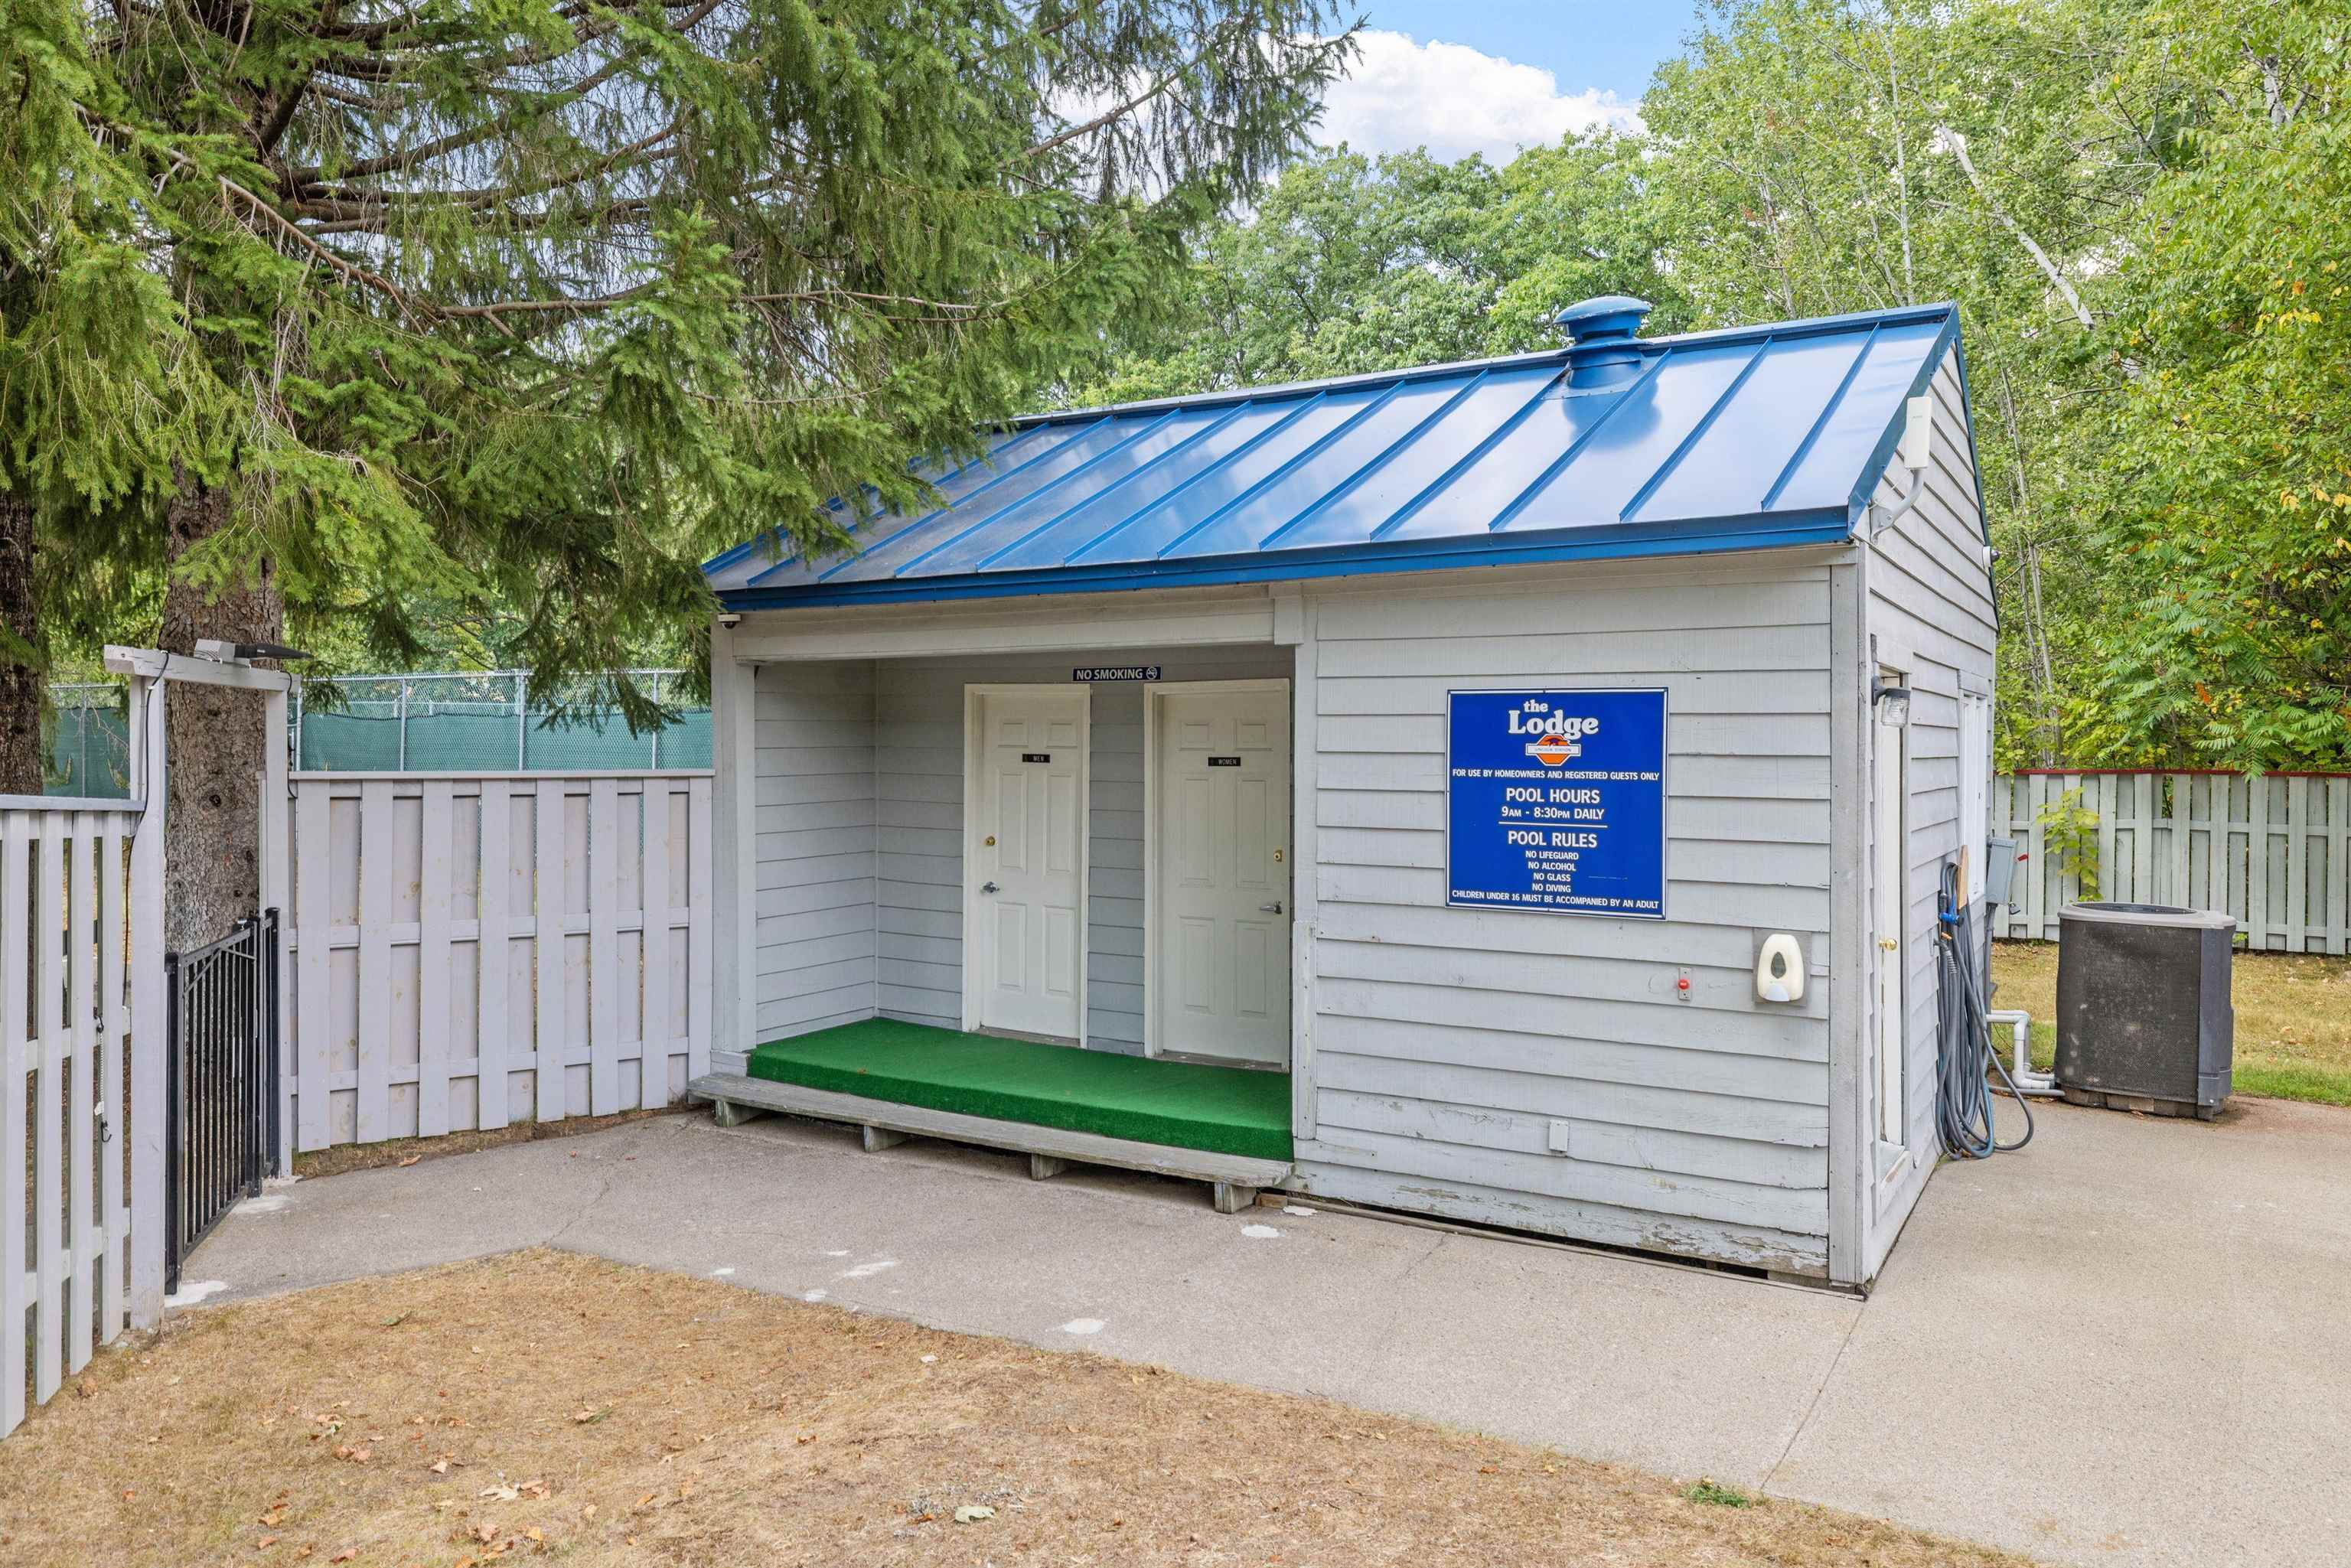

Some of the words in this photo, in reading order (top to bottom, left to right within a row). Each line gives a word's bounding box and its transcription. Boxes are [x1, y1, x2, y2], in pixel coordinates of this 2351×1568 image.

[1076, 670, 1092, 680] NO
[1094, 668, 1143, 680] SMOKING
[1523, 699, 1548, 713] the
[1508, 709, 1599, 740] Lodge
[1468, 769, 1481, 777] USE
[1495, 770, 1545, 778] HOMEOWNERS
[1547, 771, 1563, 779] AND
[1565, 771, 1608, 780] REGISTERED
[1610, 772, 1638, 781] GUESTS
[1641, 772, 1660, 781] ONLY
[1506, 788, 1544, 803] POOL
[1550, 789, 1600, 804] HOURS
[1502, 807, 1521, 817] 9AM
[1534, 807, 1570, 820] 8:30PM
[1574, 809, 1604, 820] DAILY
[1508, 831, 1546, 846] POOL
[1552, 833, 1597, 848] RULES
[1525, 850, 1537, 859] NO
[1539, 851, 1579, 860] LIFEGUARD
[1542, 862, 1577, 871] ALCOHOL
[1534, 872, 1545, 881] NO
[1547, 873, 1571, 882] GLASS
[1532, 883, 1544, 892] NO
[1546, 884, 1571, 893] DIVING
[1452, 890, 1485, 899] CHILDREN
[1486, 892, 1509, 901] UNDER
[1522, 894, 1542, 902] MUST
[1544, 895, 1554, 903] BE
[1556, 895, 1608, 906] ACCOMPANIED
[1610, 898, 1621, 907] BY
[1622, 899, 1633, 908] AN
[1635, 900, 1658, 909] ADULT
